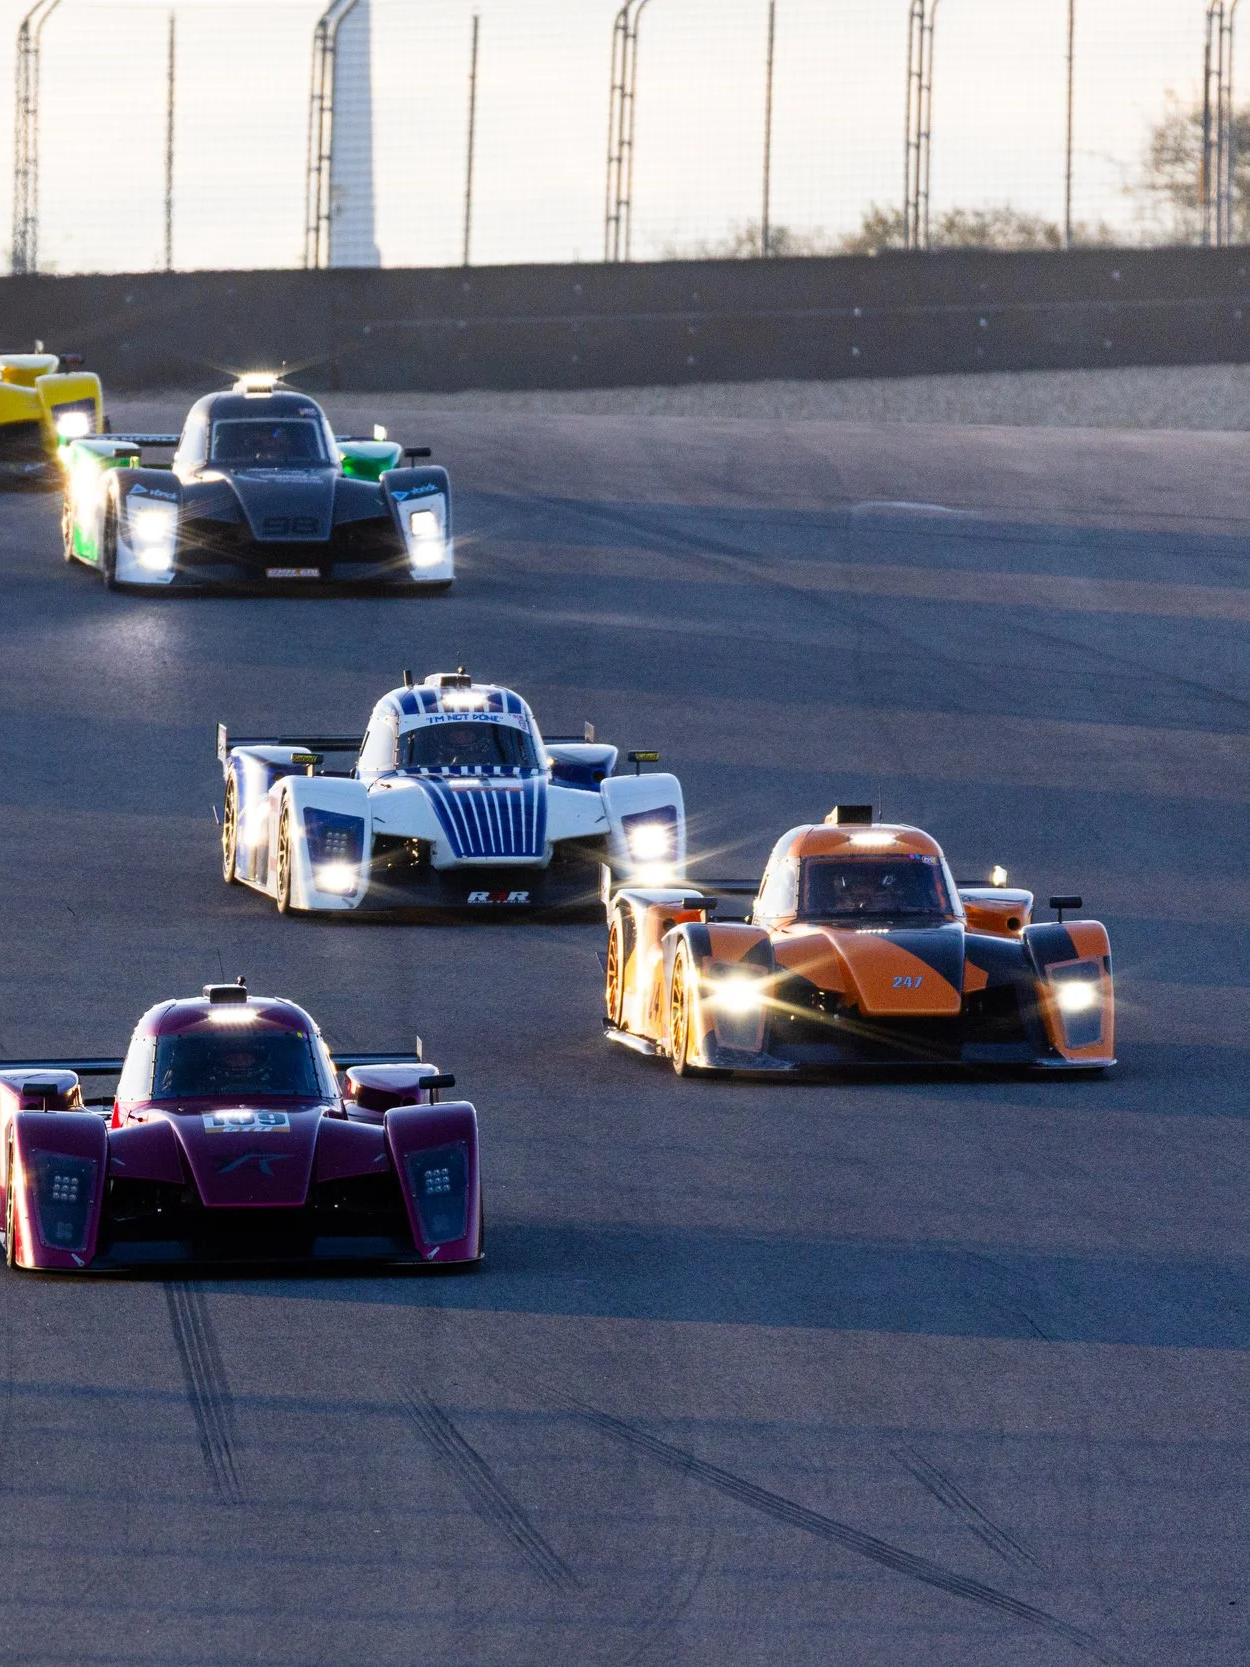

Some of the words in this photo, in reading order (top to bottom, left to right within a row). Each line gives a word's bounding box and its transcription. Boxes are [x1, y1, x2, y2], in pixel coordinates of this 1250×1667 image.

[447, 714, 468, 722] NOT
[892, 976, 923, 989] 247
[204, 1111, 287, 1126] 109
